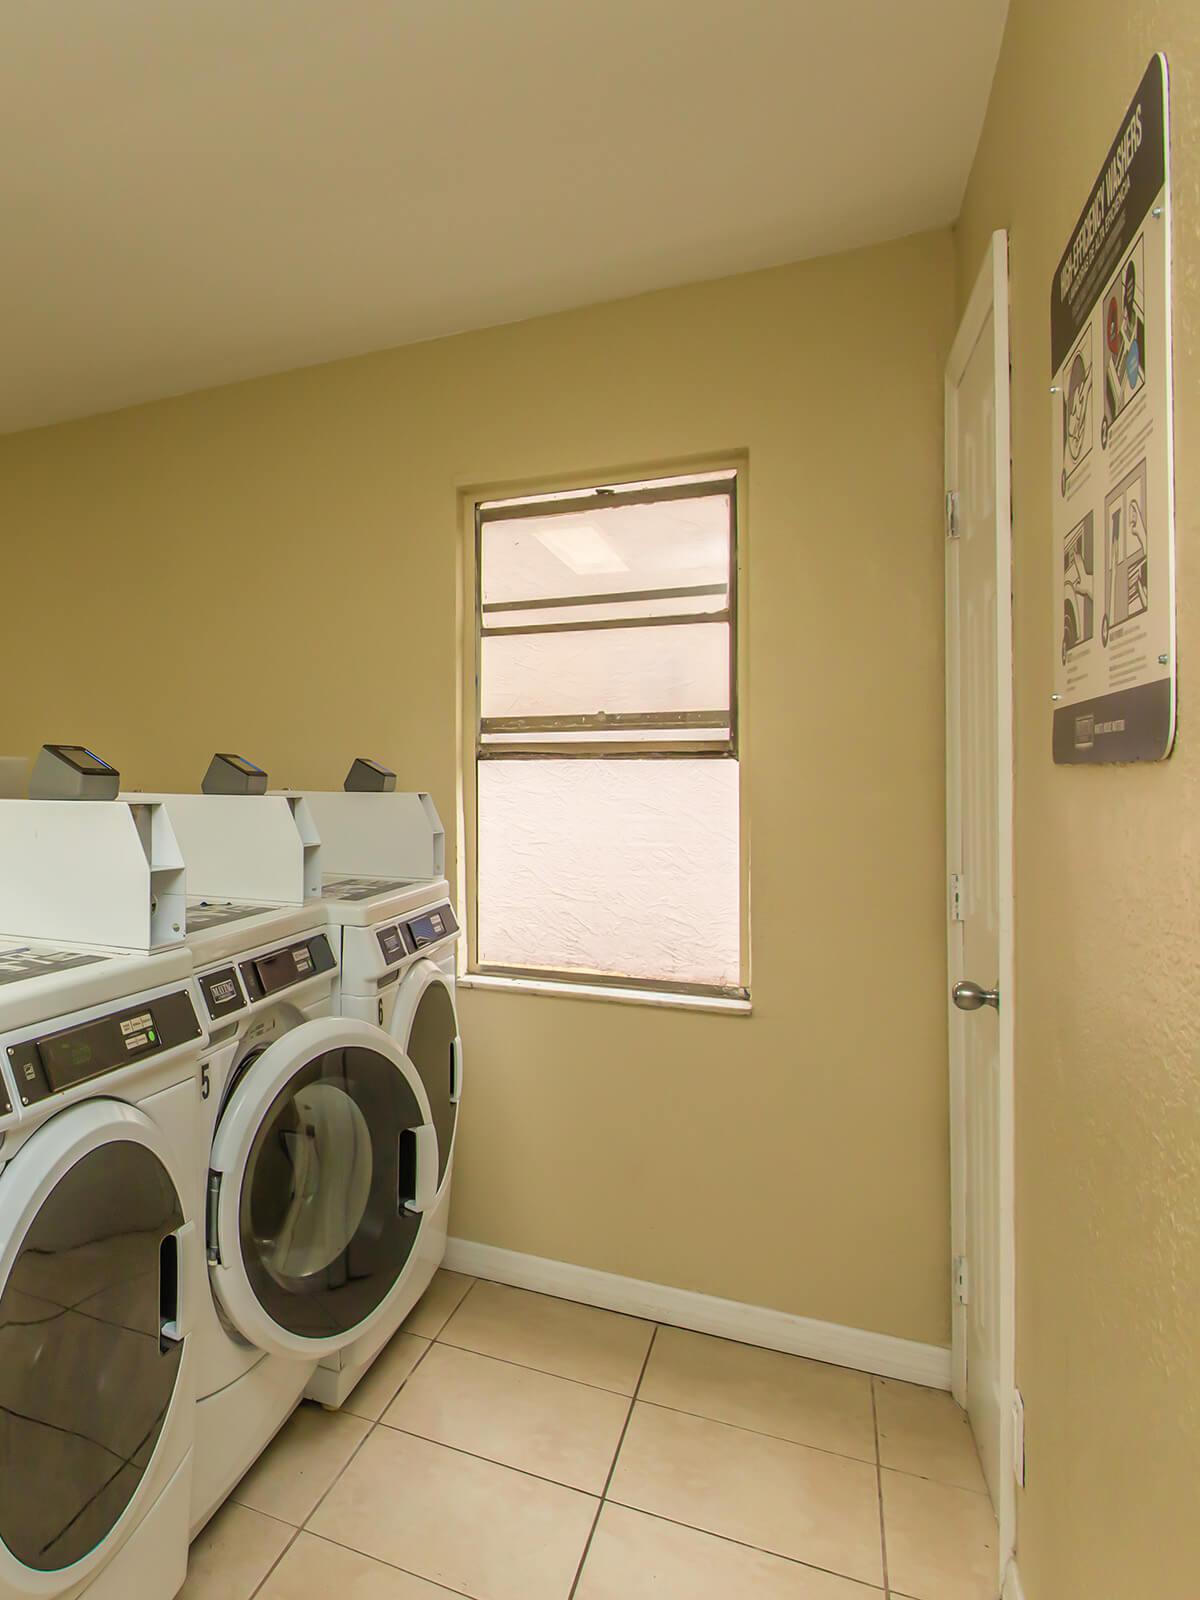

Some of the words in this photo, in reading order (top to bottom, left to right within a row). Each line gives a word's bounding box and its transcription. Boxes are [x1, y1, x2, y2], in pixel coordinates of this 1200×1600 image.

[1105, 103, 1142, 207] WASHERS
[378, 998, 383, 1026] 6
[201, 1063, 209, 1100] 5
